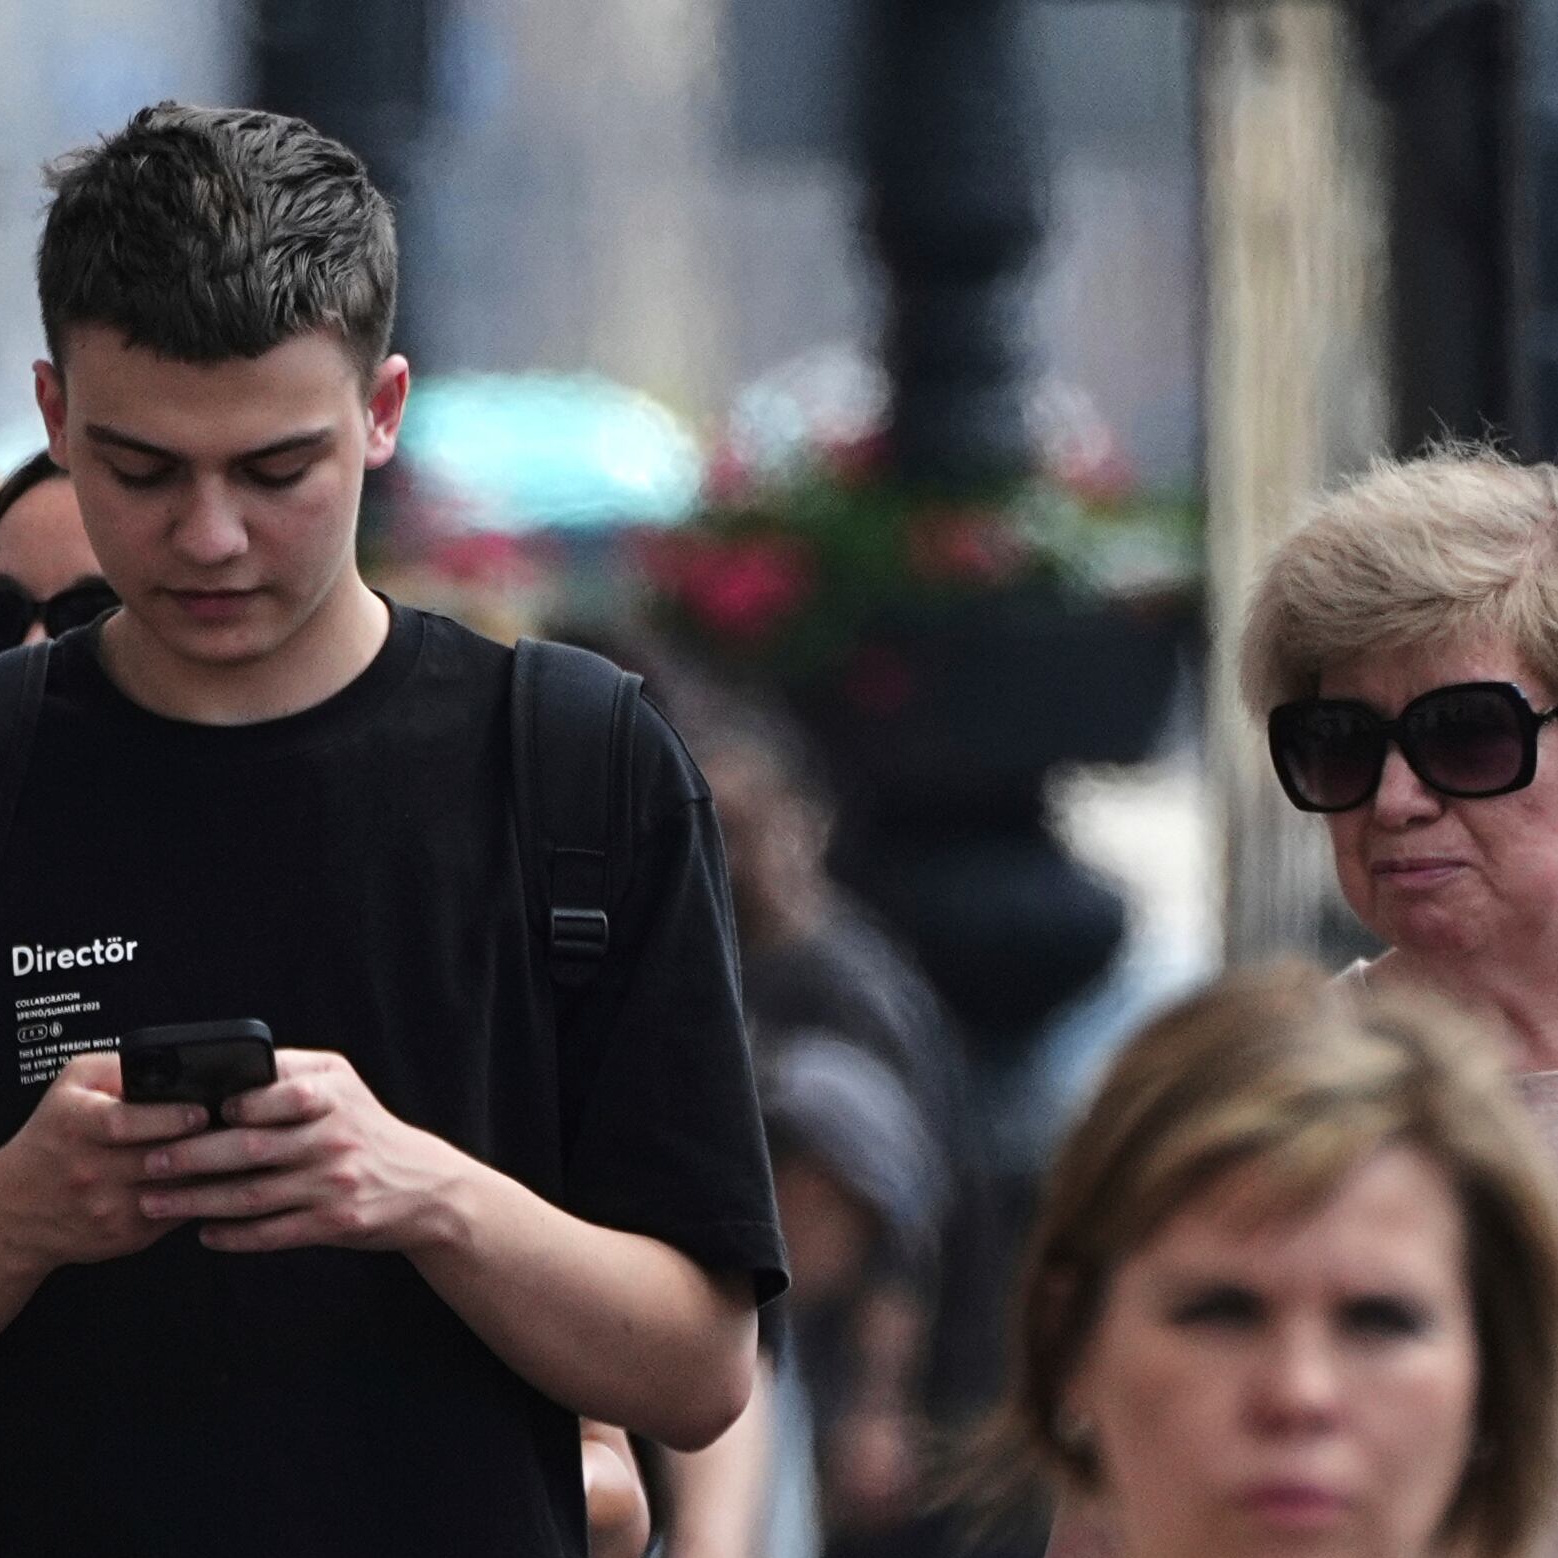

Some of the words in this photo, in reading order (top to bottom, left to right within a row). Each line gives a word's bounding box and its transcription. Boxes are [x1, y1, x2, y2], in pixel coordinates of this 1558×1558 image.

[15, 992, 81, 1009] COLLABORATION
[19, 1048, 34, 1059] THIS
[45, 1044, 58, 1054] THE
[59, 1040, 91, 1053] PERSON
